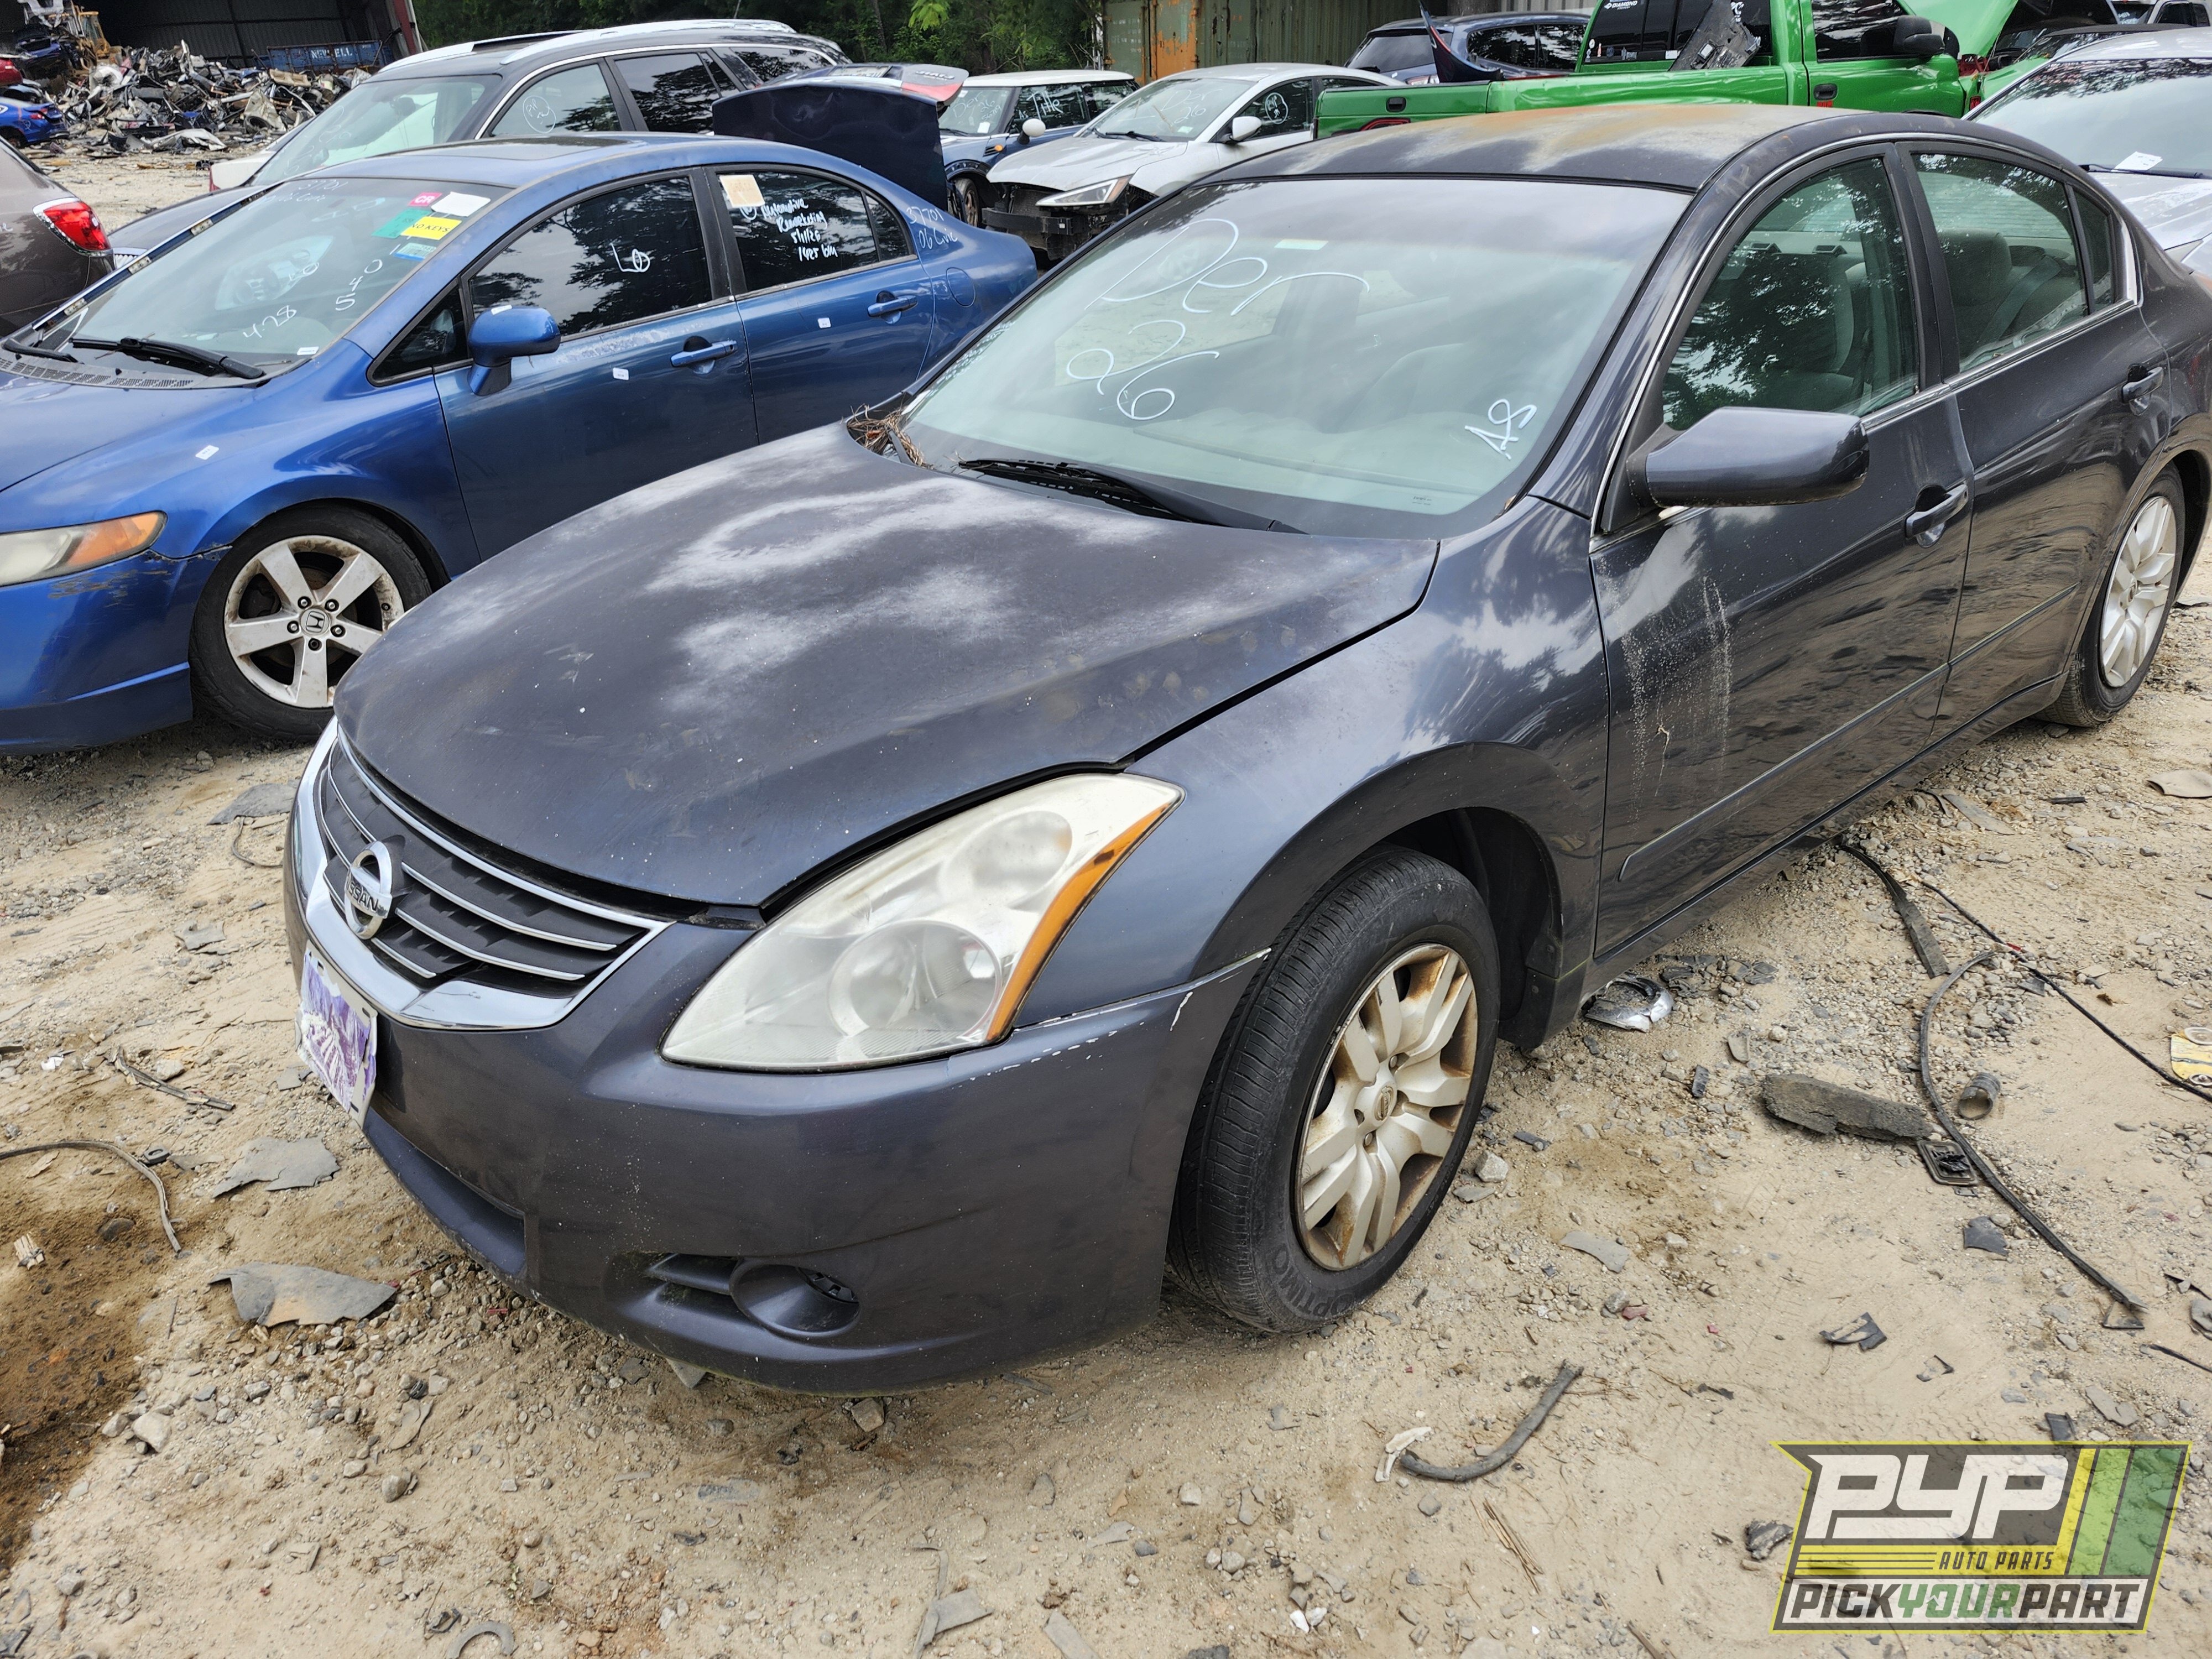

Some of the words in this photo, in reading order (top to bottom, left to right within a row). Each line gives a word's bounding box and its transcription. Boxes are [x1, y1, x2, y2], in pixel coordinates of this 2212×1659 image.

[906, 206, 945, 226] 37701
[1084, 218, 1370, 316] Der
[347, 872, 379, 913] ISSAN
